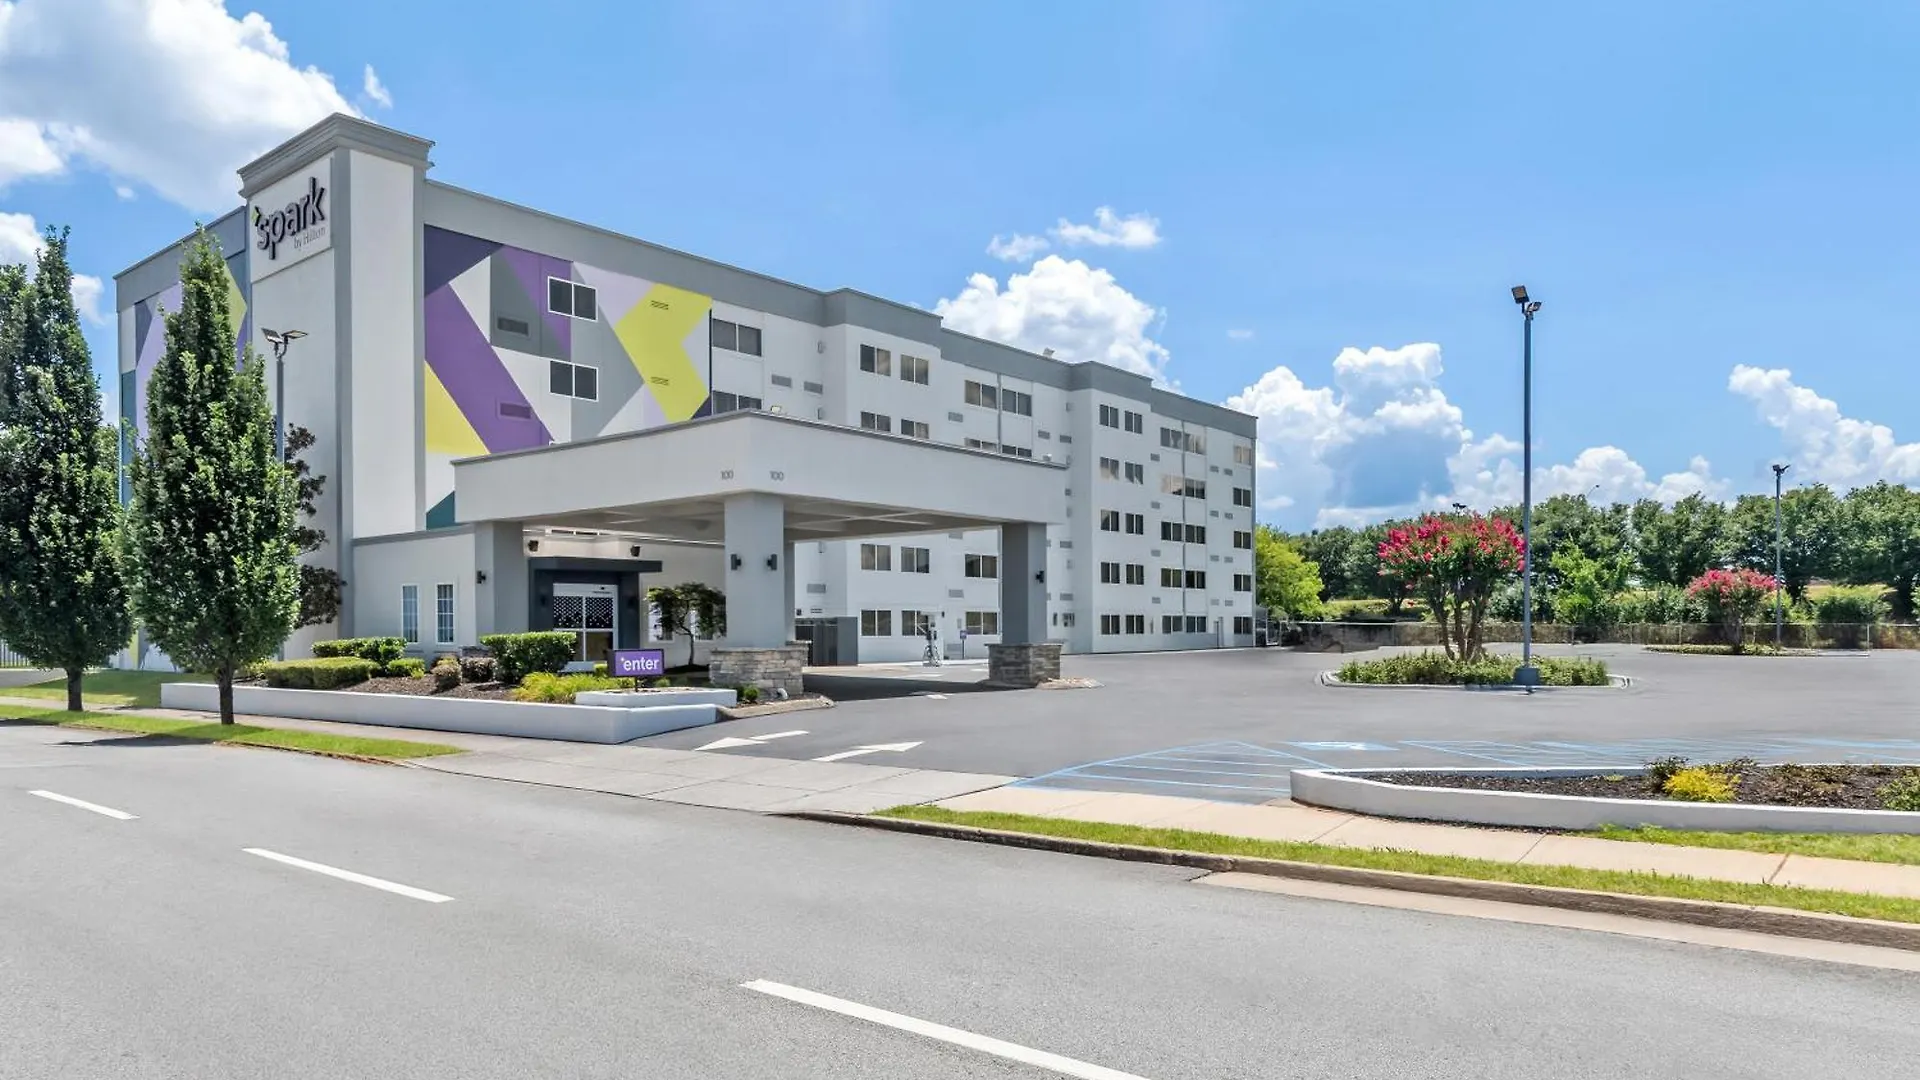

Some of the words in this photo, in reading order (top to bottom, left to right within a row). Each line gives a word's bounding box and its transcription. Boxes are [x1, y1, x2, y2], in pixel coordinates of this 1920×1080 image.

[257, 176, 325, 260] spark
[720, 469, 734, 480] 100
[623, 657, 659, 671] enter
